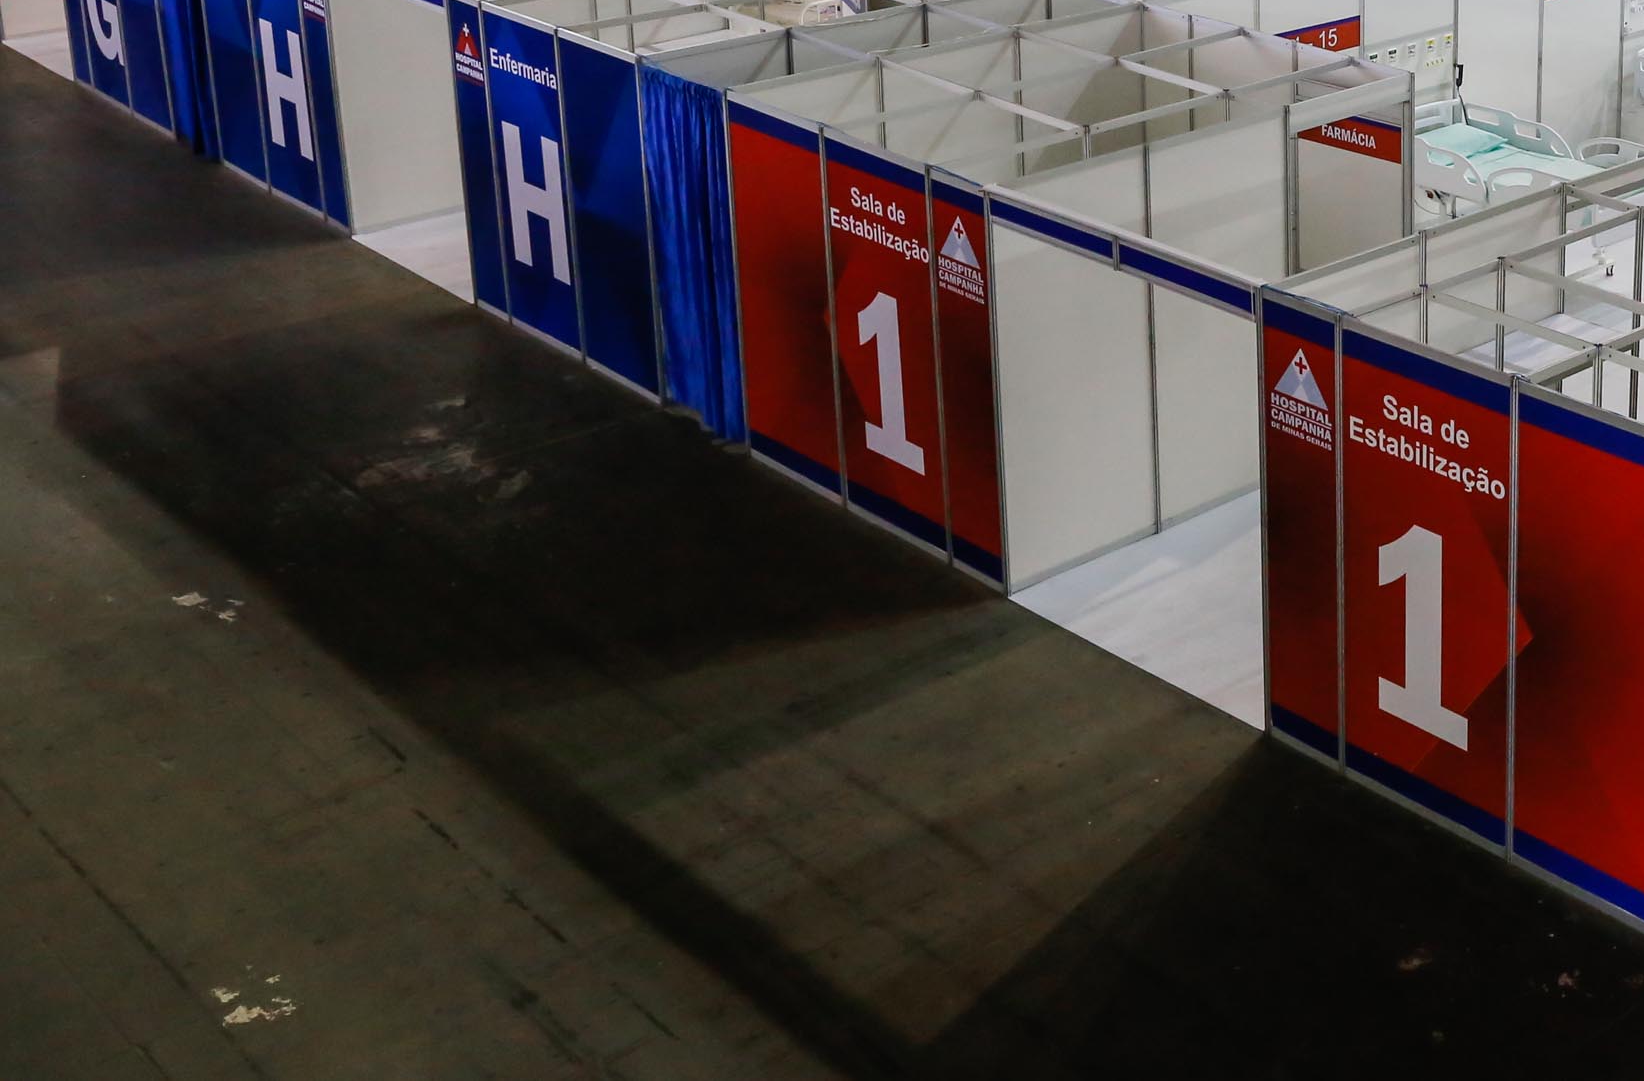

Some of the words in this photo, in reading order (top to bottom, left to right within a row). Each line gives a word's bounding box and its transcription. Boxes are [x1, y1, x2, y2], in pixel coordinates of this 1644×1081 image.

[1319, 28, 1338, 49] 15
[258, 18, 314, 162] H
[489, 47, 558, 91] Enfermaria
[1321, 124, 1377, 149] FARMÁCIA
[501, 121, 572, 286] H
[850, 186, 883, 217] Sala
[887, 202, 906, 226] de
[829, 206, 930, 264] Estabilização
[937, 255, 984, 284] HOSPITAL
[938, 270, 984, 297] CAMPANHA
[857, 290, 926, 476] 1
[1271, 392, 1332, 427] HOSPITAL
[1271, 408, 1332, 443] CAMPANHA
[1382, 394, 1433, 436] Sala
[1440, 419, 1470, 450] de
[1271, 421, 1281, 430] DE
[1282, 425, 1305, 440] MINAS
[1306, 435, 1332, 451] GERAIS
[1349, 415, 1506, 500] Estabilização
[1378, 524, 1468, 752] 1
